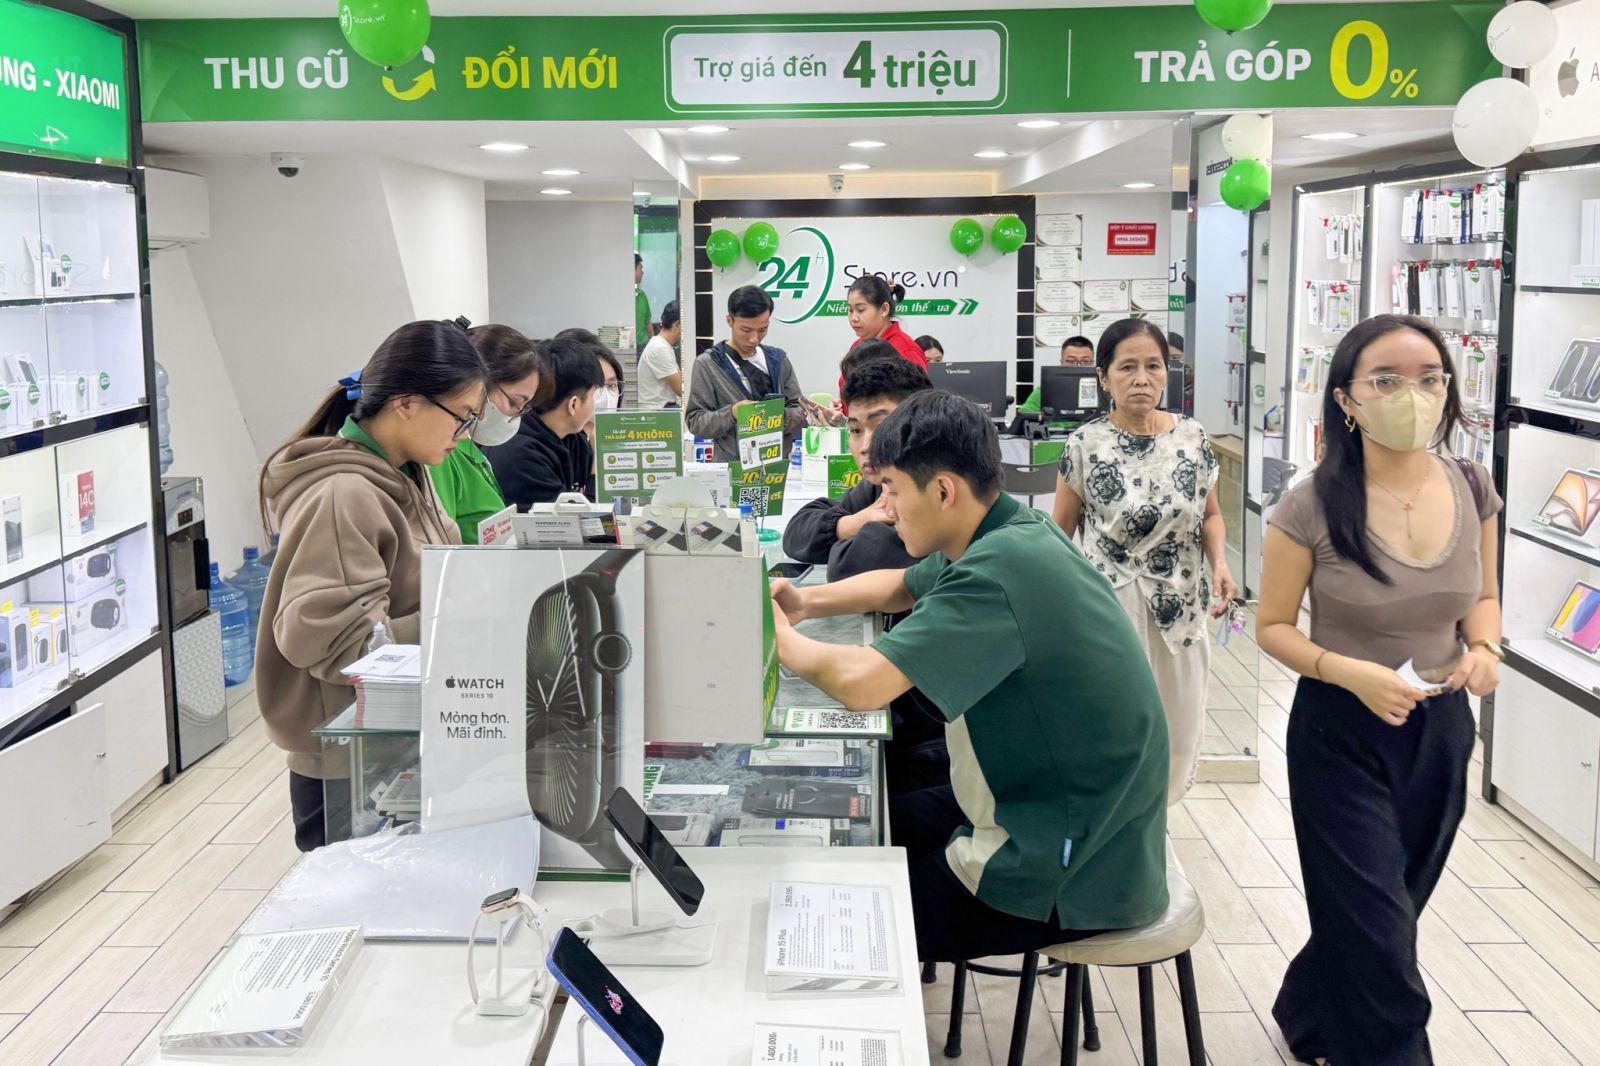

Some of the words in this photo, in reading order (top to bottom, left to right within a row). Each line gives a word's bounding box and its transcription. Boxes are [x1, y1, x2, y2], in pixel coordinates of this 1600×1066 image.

[204, 57, 285, 90] THU
[297, 48, 349, 90] CŨ
[461, 46, 530, 89] ĐỔI
[542, 48, 618, 89] MỚI
[694, 57, 733, 82] Trợ
[740, 55, 775, 83] giá
[783, 53, 827, 78] đến
[843, 40, 876, 88] 4
[883, 50, 976, 95] triệu
[1134, 40, 1216, 83] TRẢ
[1225, 41, 1311, 82] GÓP
[55, 68, 120, 110] XIAOMI
[759, 256, 811, 299] 24
[911, 301, 929, 312] thế
[627, 430, 635, 440] 4
[637, 428, 673, 439] KHÔNG
[457, 678, 504, 689] WATCH
[440, 711, 478, 726] Mỏng
[481, 711, 509, 724] hơn.
[447, 727, 470, 739] Mãi
[474, 726, 506, 739] đỉnh.
[780, 929, 788, 939] Plus
[777, 946, 786, 966] iPhone
